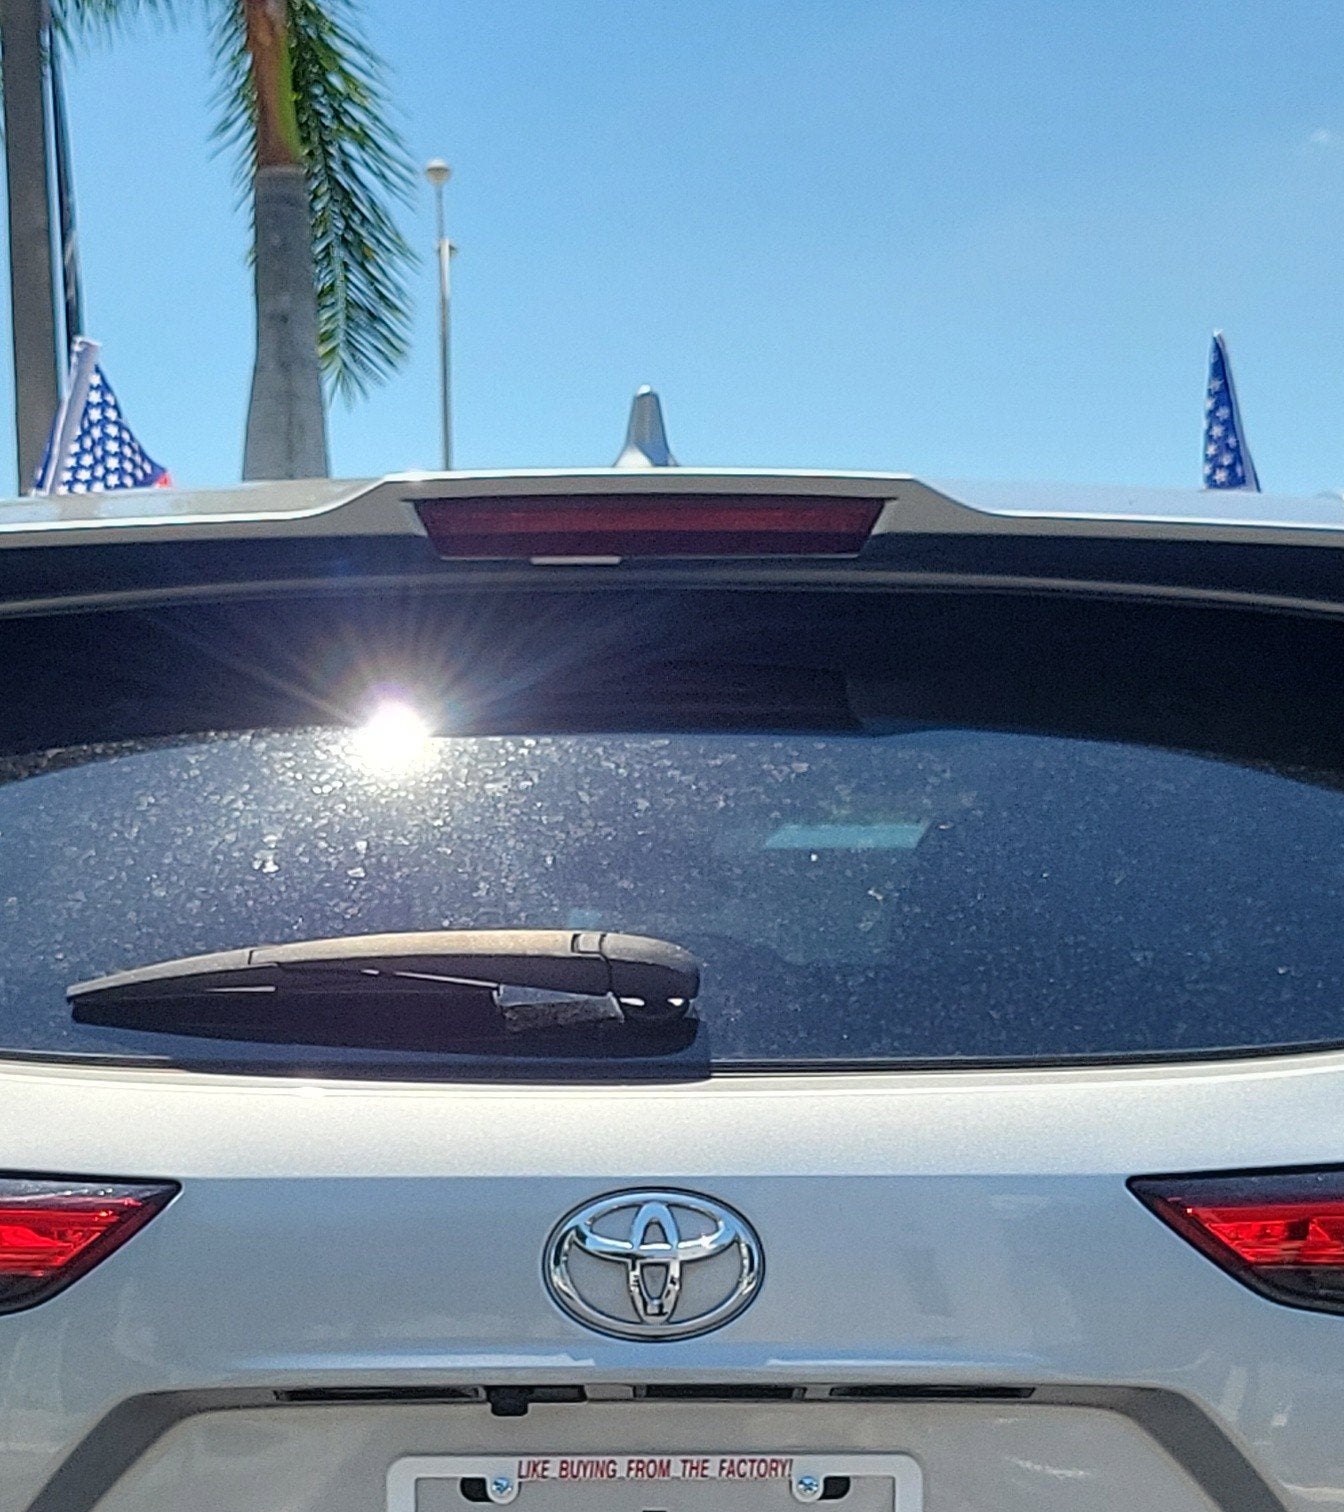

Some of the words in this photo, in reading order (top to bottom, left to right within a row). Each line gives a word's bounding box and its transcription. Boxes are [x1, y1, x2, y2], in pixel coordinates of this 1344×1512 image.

[517, 1458, 550, 1479] LIKE
[559, 1458, 617, 1479] BUYING
[627, 1458, 671, 1479] FROM
[681, 1458, 709, 1478] THE
[719, 1457, 794, 1478] FACTORY!
